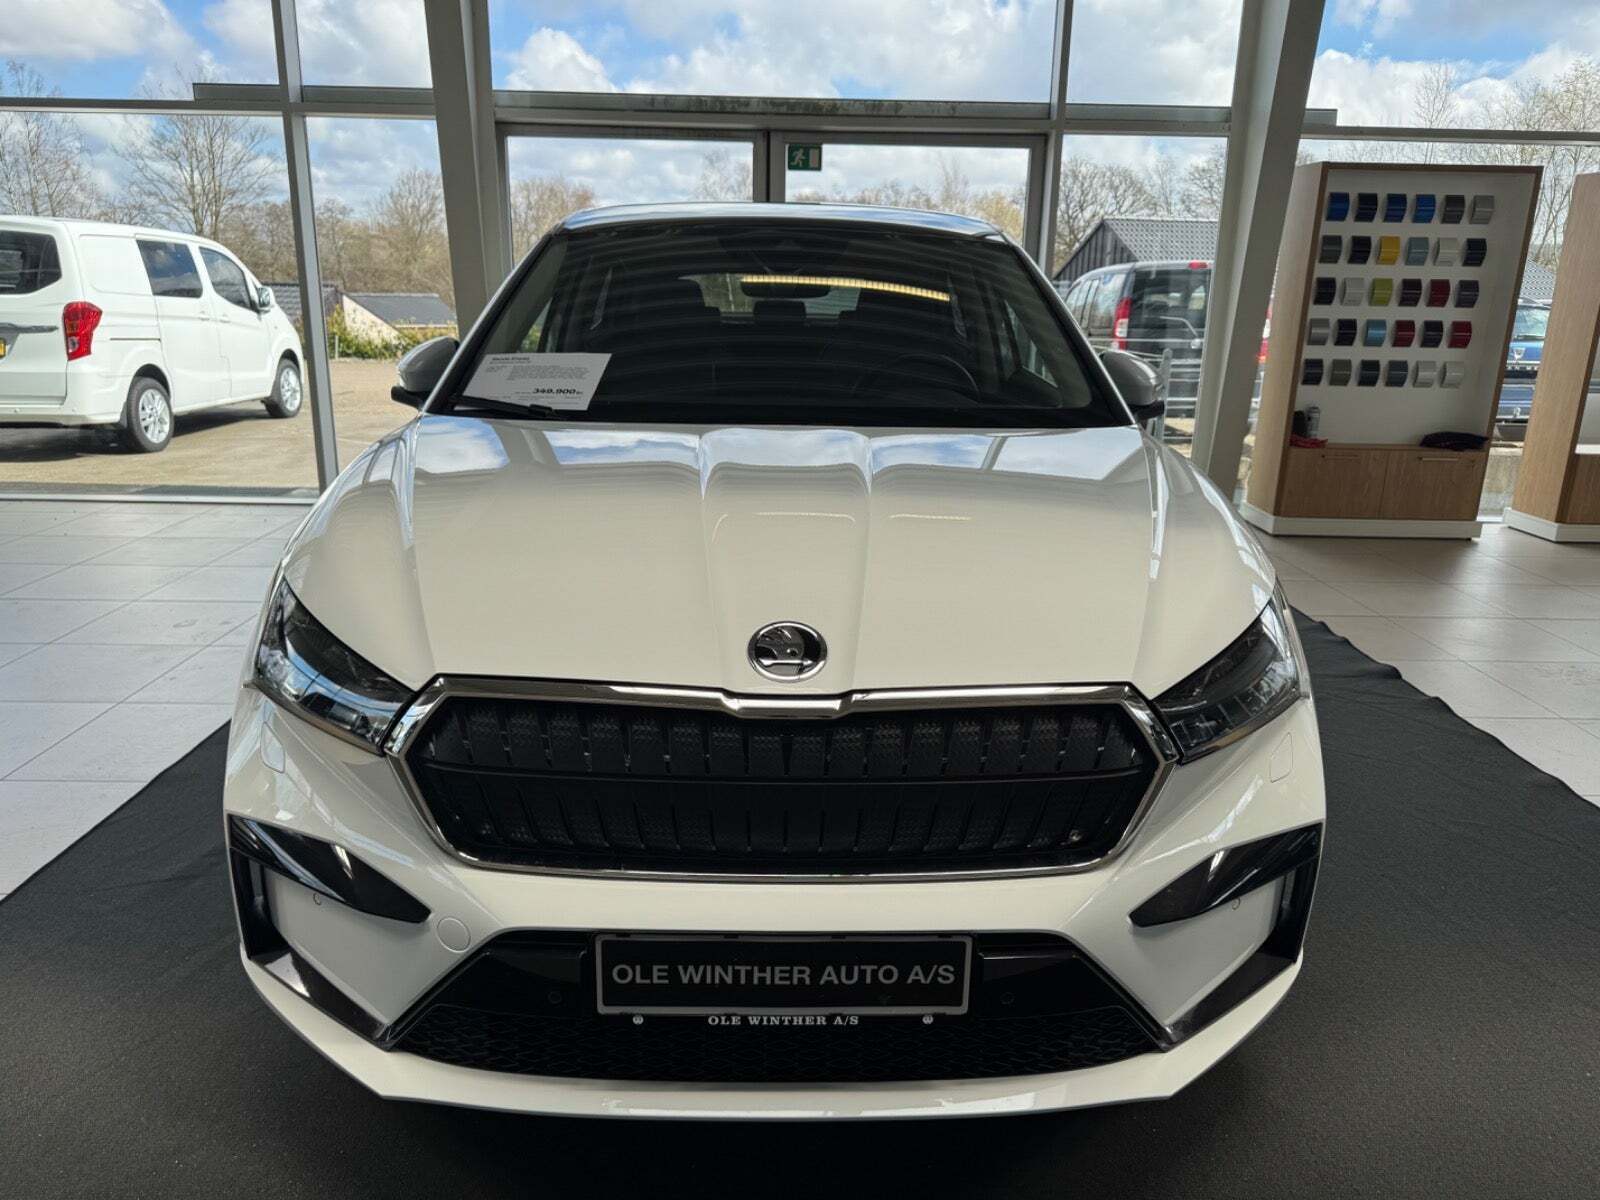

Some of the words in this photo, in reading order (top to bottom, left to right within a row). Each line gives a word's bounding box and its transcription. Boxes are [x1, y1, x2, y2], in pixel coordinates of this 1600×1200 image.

[612, 965, 669, 984] OLE
[678, 965, 810, 985] WINTHER
[819, 965, 898, 985] AUTO
[907, 965, 955, 985] A/S
[707, 1015, 742, 1026] OLE
[748, 1015, 827, 1026] WINTHER
[833, 1015, 860, 1026] A/S
